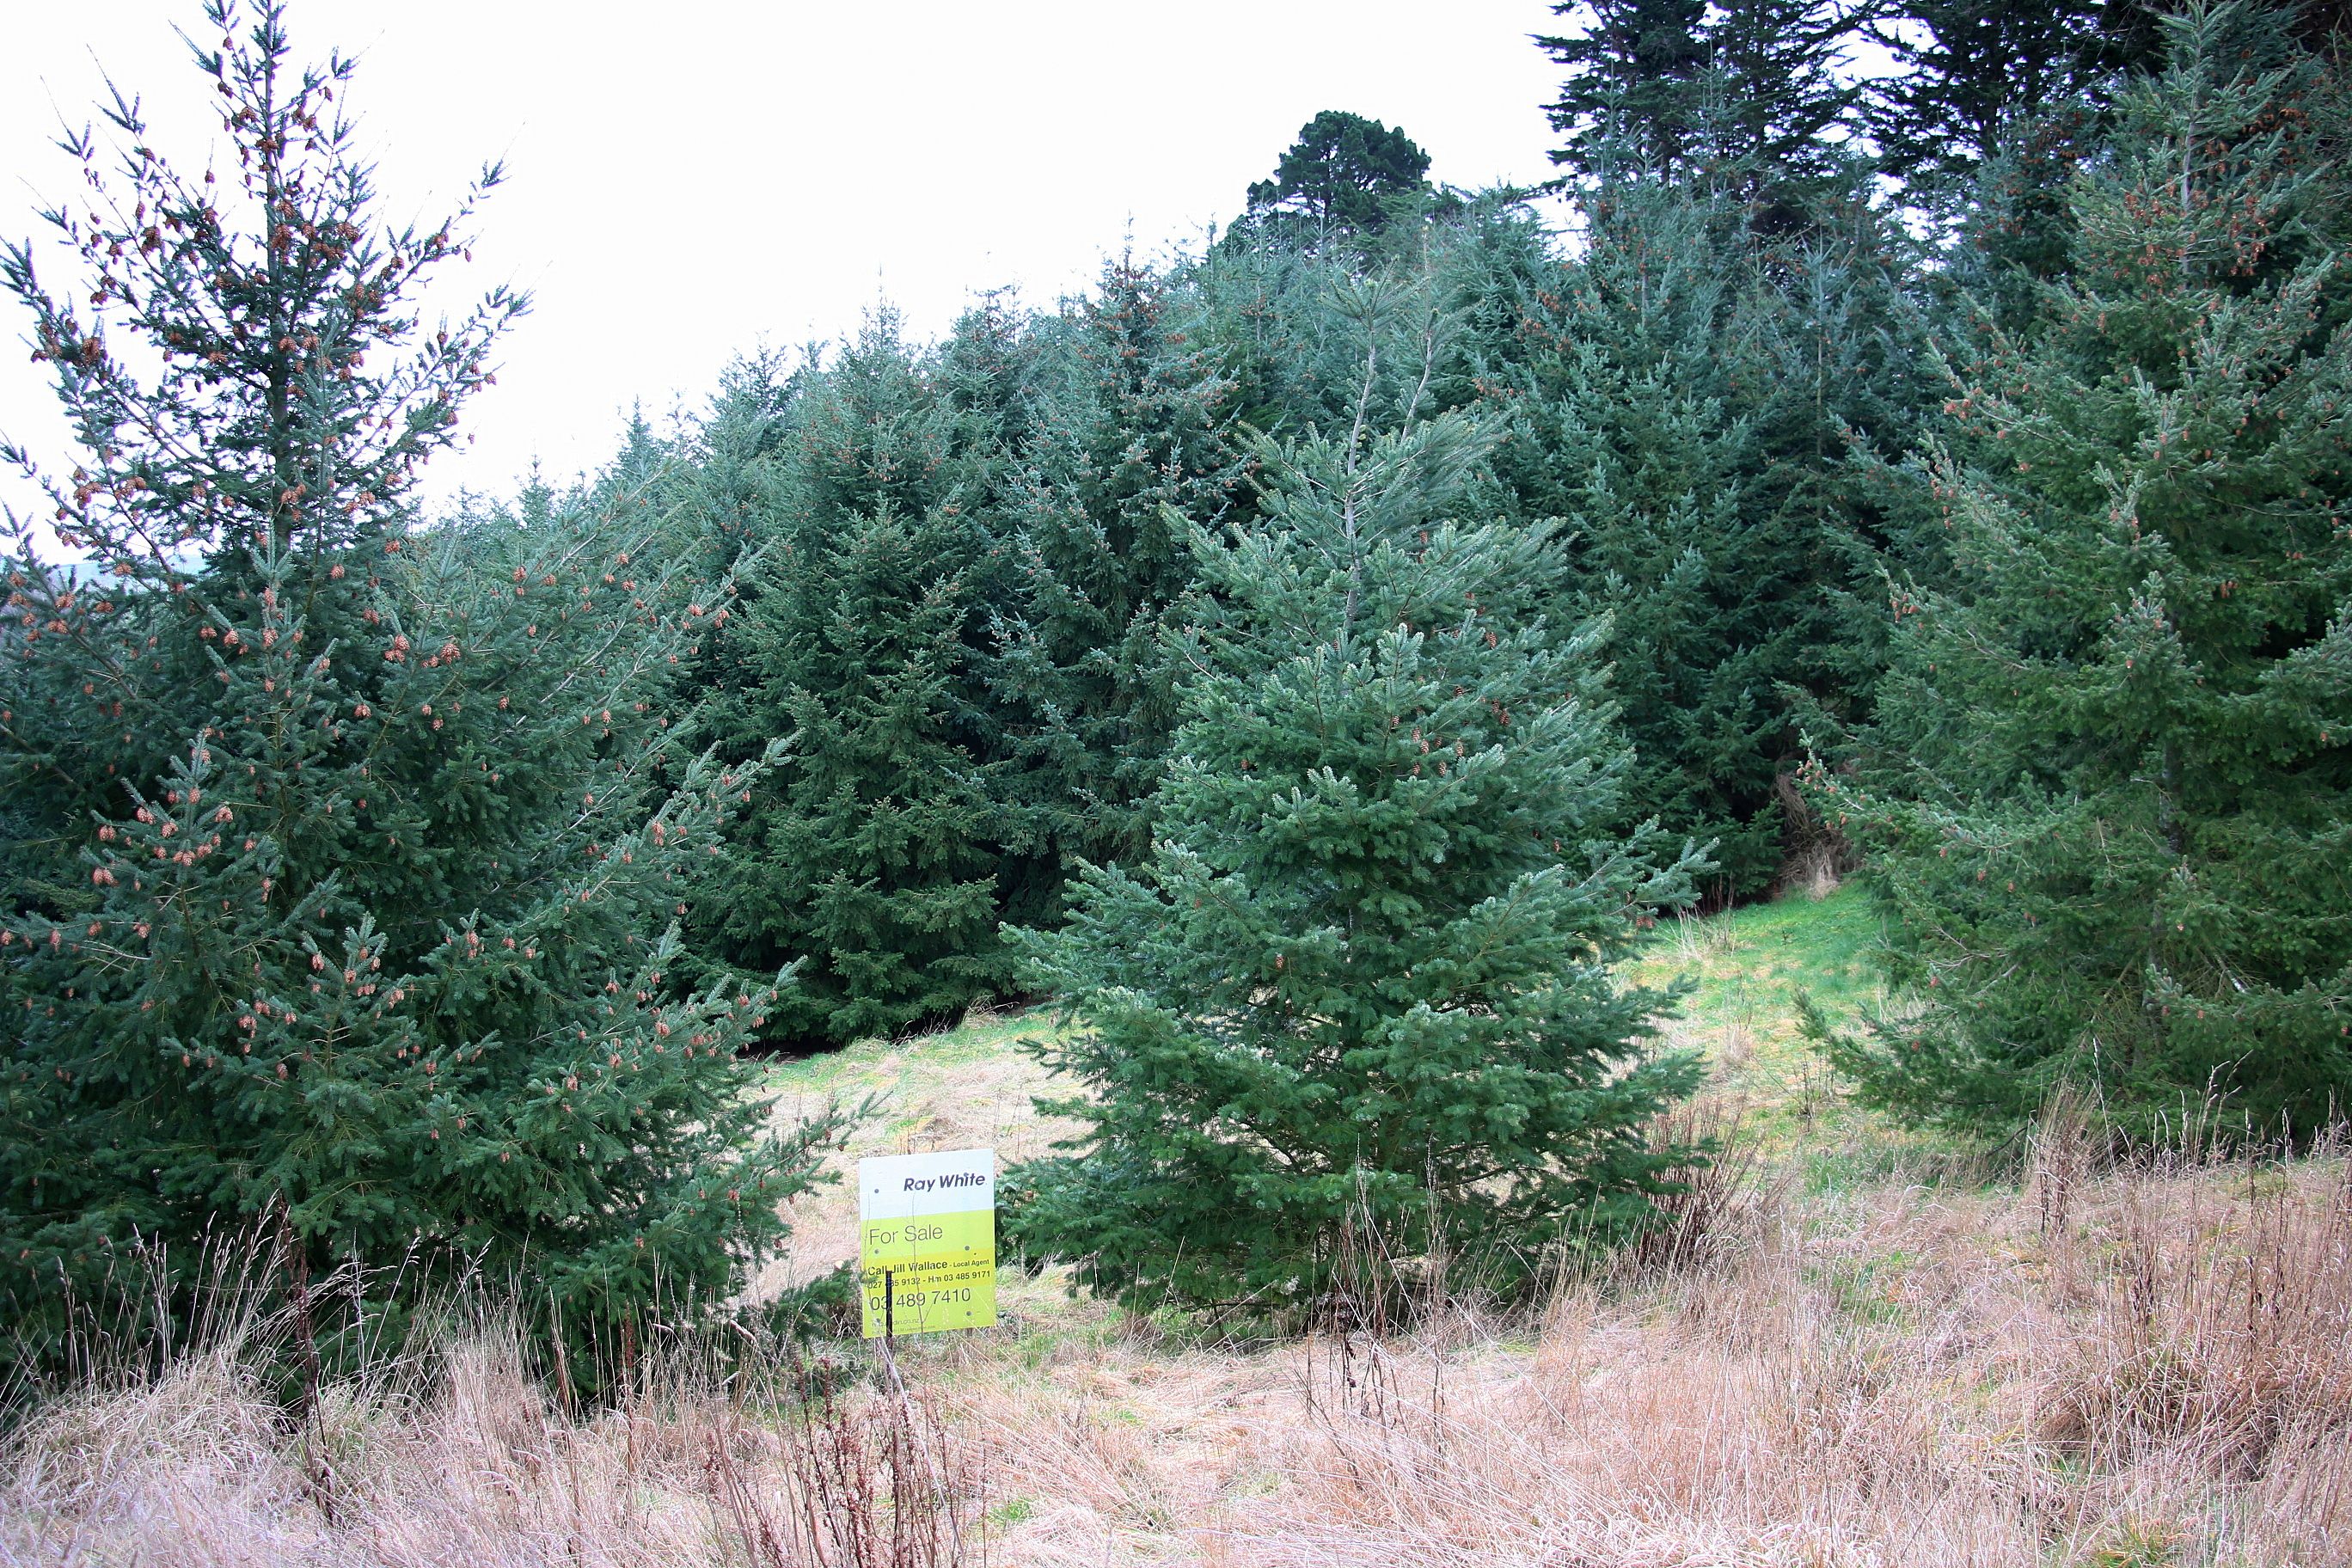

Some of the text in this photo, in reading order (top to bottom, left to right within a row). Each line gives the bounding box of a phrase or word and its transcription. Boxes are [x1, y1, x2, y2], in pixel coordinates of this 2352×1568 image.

[903, 1173, 985, 1192] Ray White
[869, 1224, 943, 1245] For Sale
[891, 1264, 905, 1273] Jill
[909, 1261, 947, 1271] Wallace
[901, 1277, 921, 1286] 9132
[972, 1270, 990, 1278] 9171
[896, 1292, 926, 1308] 489
[931, 1288, 971, 1304] 7410
